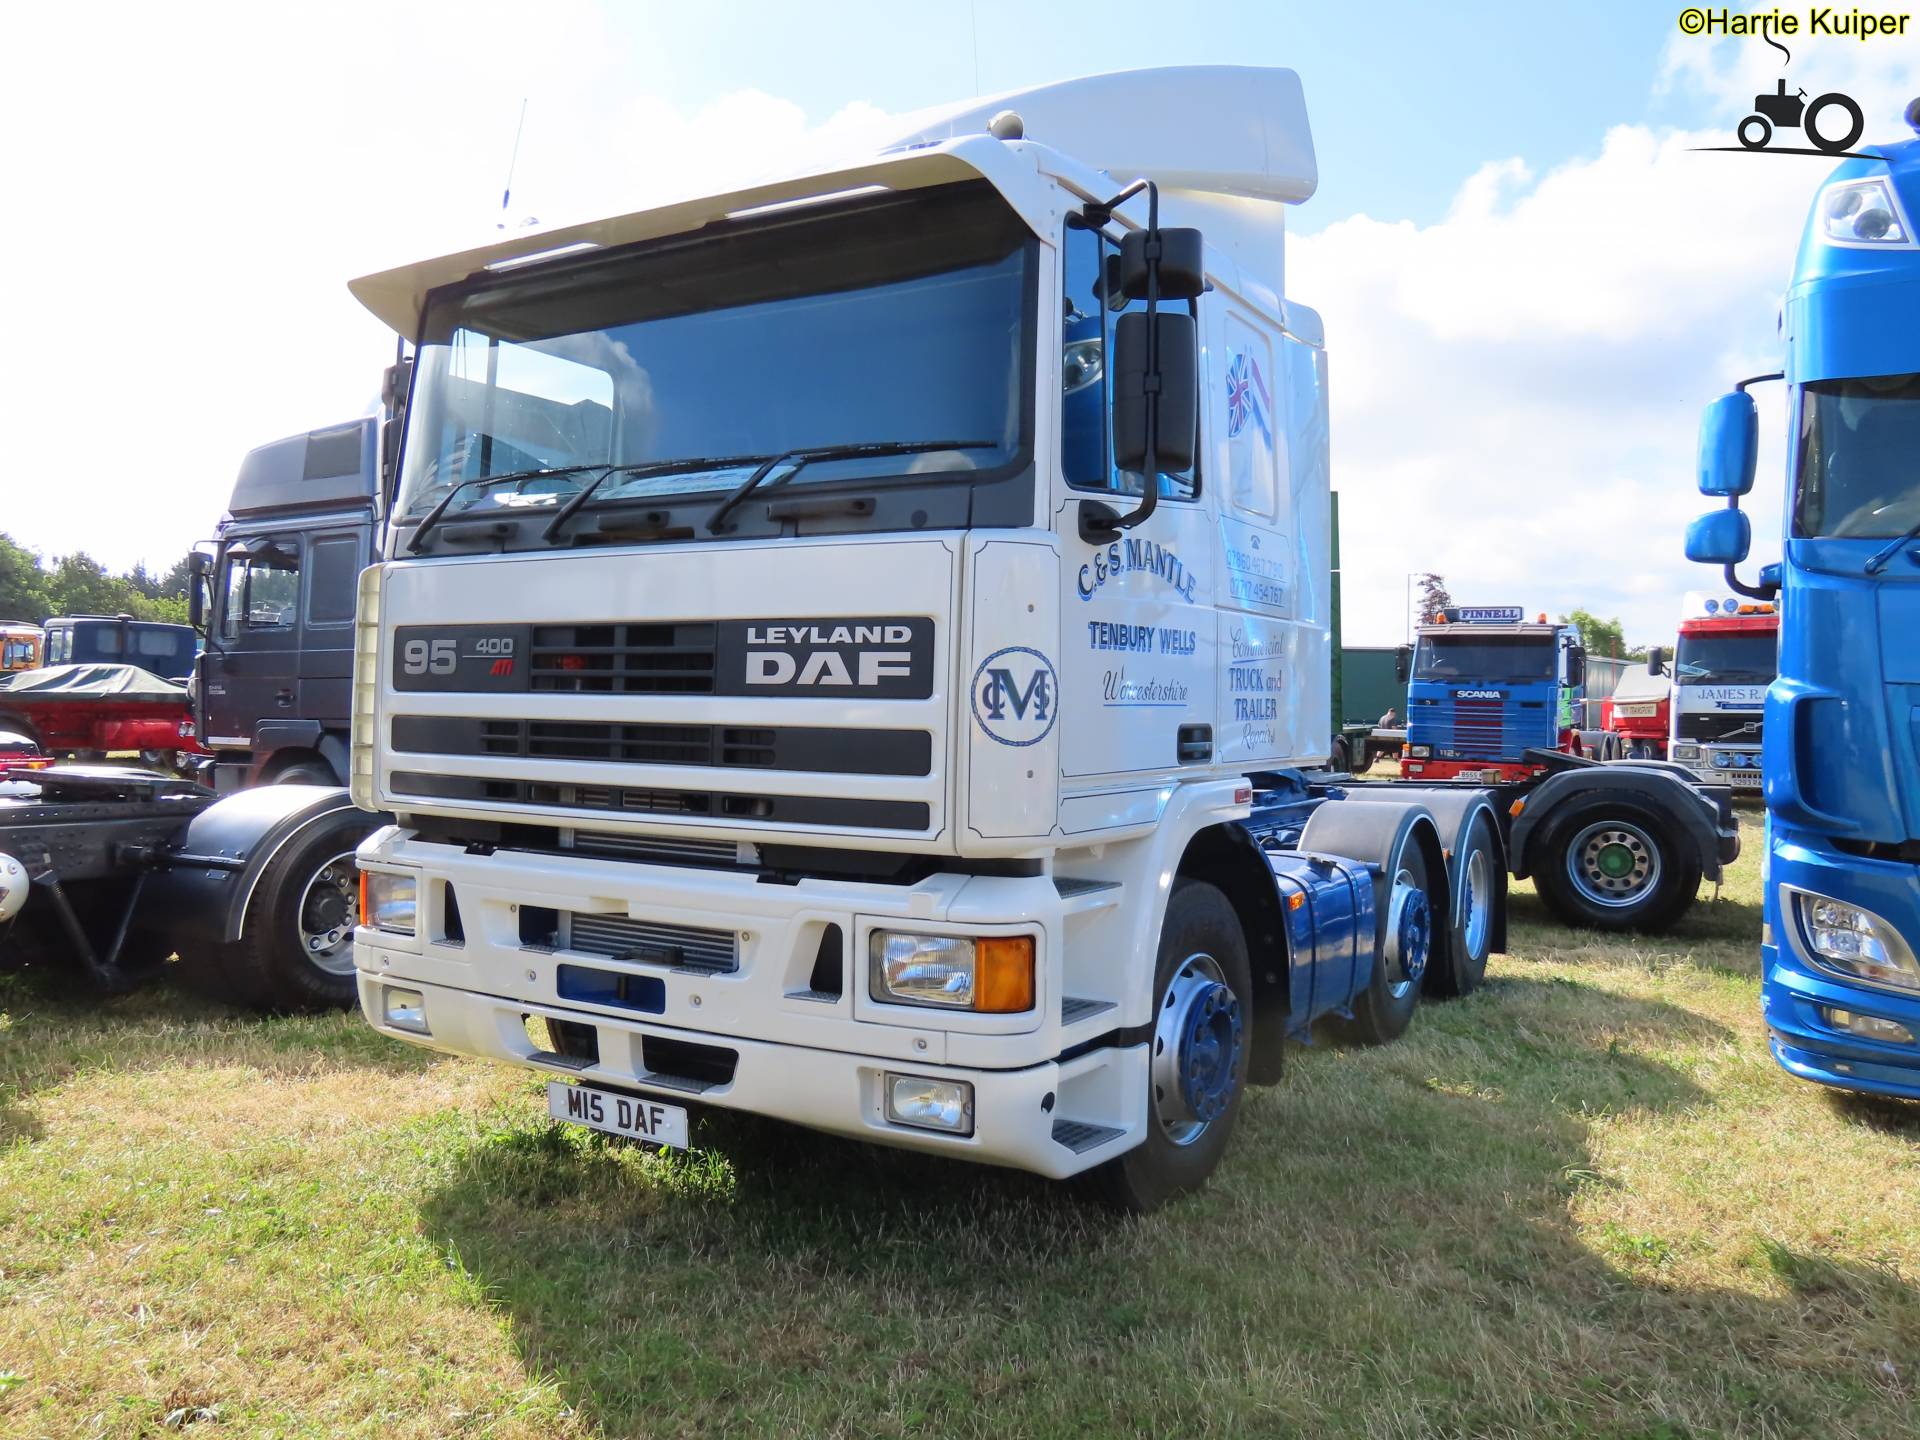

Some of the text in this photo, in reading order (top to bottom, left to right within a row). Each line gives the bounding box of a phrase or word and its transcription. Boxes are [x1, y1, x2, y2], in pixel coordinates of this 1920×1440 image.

[1461, 608, 1518, 620] FINNELL
[476, 638, 514, 654] 400
[746, 625, 913, 644] LEYLAND
[1087, 620, 1196, 655] TENBURY WELLS
[404, 639, 457, 675] 95
[745, 651, 912, 686] DAF
[1102, 664, 1188, 701] Worcestershire
[1229, 667, 1283, 692] TRUCK and
[1457, 690, 1501, 699] SCANIA
[1698, 688, 1745, 700] JAMES
[1234, 698, 1278, 720] TRAILER
[616, 1099, 665, 1136] DAF
